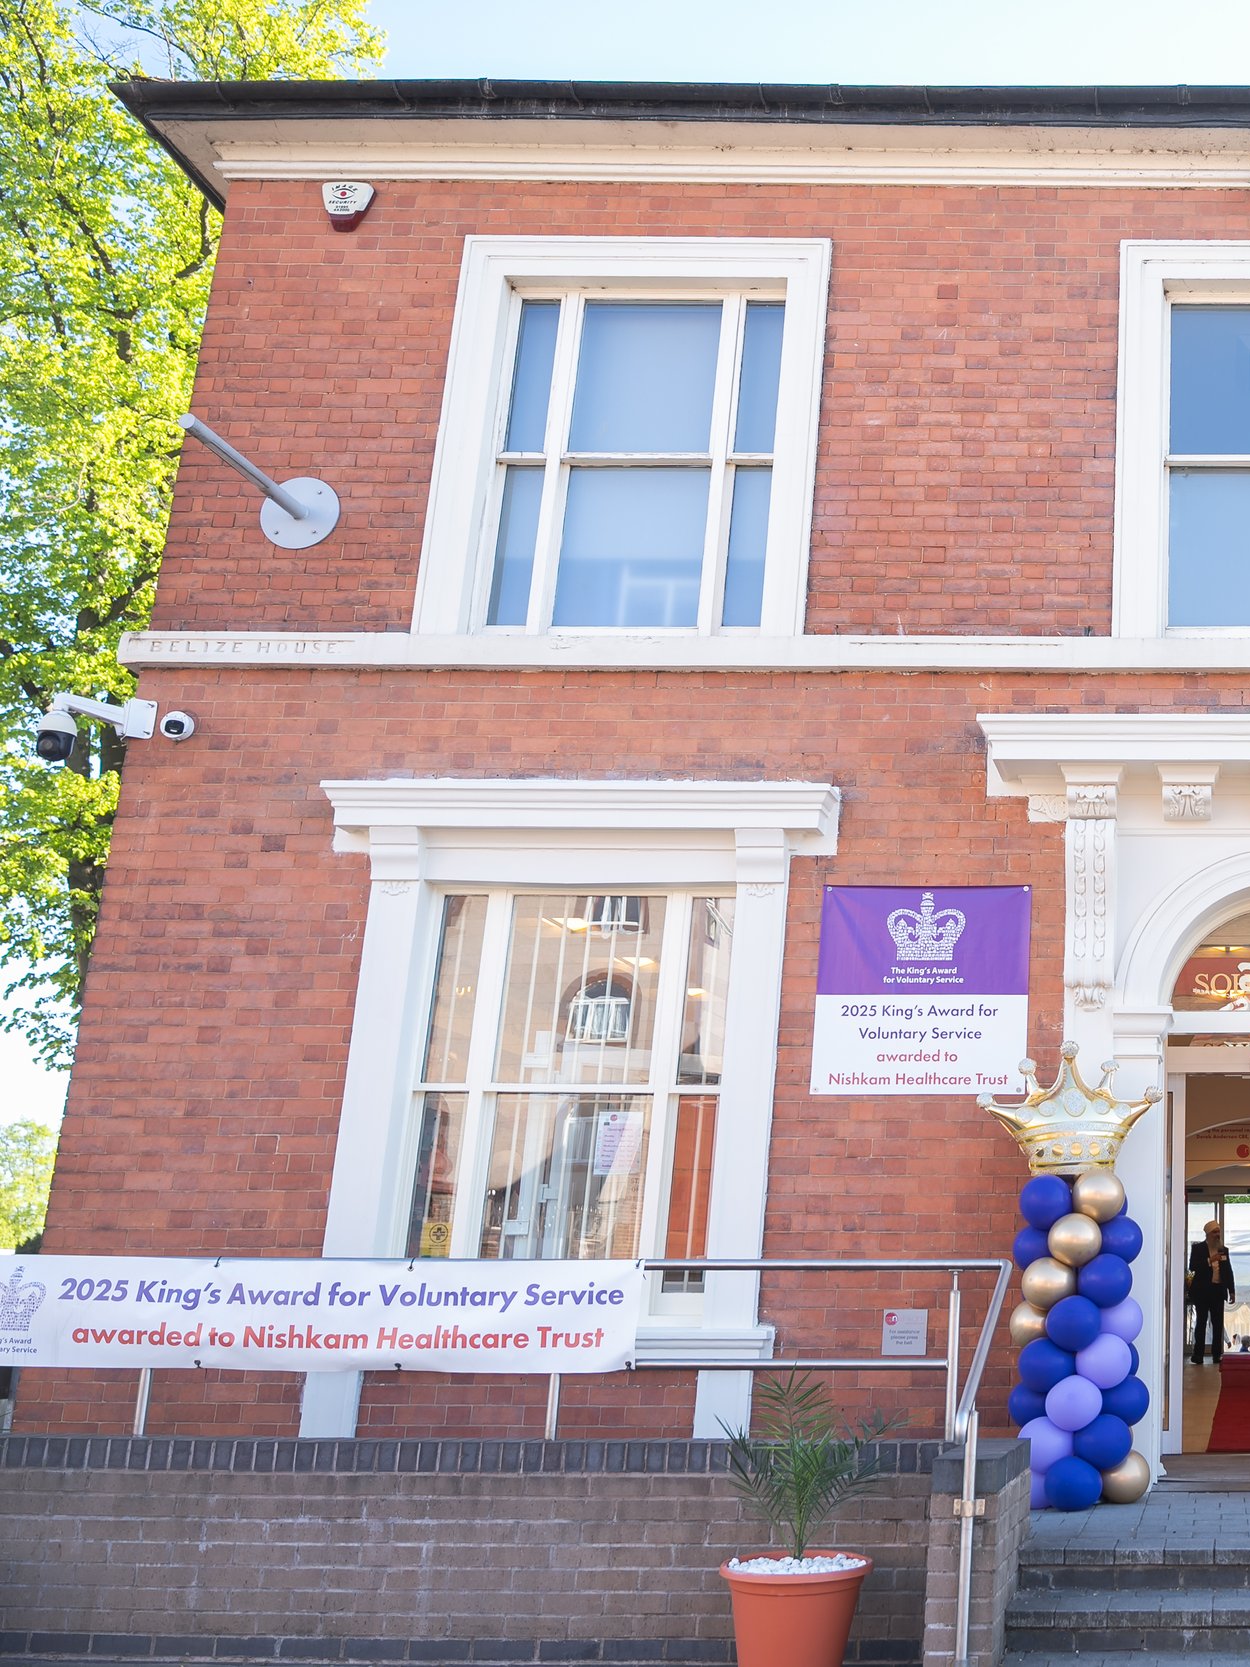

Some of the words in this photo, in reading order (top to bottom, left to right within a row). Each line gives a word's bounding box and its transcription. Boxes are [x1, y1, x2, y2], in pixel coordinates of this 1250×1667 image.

[150, 640, 244, 653] BELIZE
[907, 966, 931, 976] King's
[932, 966, 957, 974] Award
[883, 976, 895, 984] for
[896, 976, 935, 985] Voluntary
[936, 976, 964, 984] Service
[841, 1004, 877, 1017] 2025
[882, 1004, 923, 1020] King's
[927, 1004, 974, 1017] Award
[978, 1004, 999, 1017] for
[859, 1027, 927, 1043] Voluntary
[931, 1027, 982, 1040] Service
[876, 1050, 940, 1062] awarded
[944, 1051, 958, 1062] to
[828, 1073, 891, 1085] Nishkam
[895, 1073, 972, 1085] Healthcare
[976, 1073, 1008, 1085] Trust
[58, 1278, 129, 1301] 2025
[136, 1280, 222, 1311] King's
[226, 1282, 321, 1306] Award
[328, 1282, 371, 1307] for
[379, 1283, 518, 1313] Voluntary
[524, 1281, 624, 1305] Service
[9, 1337, 32, 1345] Award
[72, 1322, 203, 1348] awarded
[208, 1327, 235, 1348] to
[243, 1324, 369, 1349] Nishkam
[376, 1325, 530, 1349] Healthcare
[537, 1326, 605, 1348] Trust
[12, 1346, 37, 1354] Service
